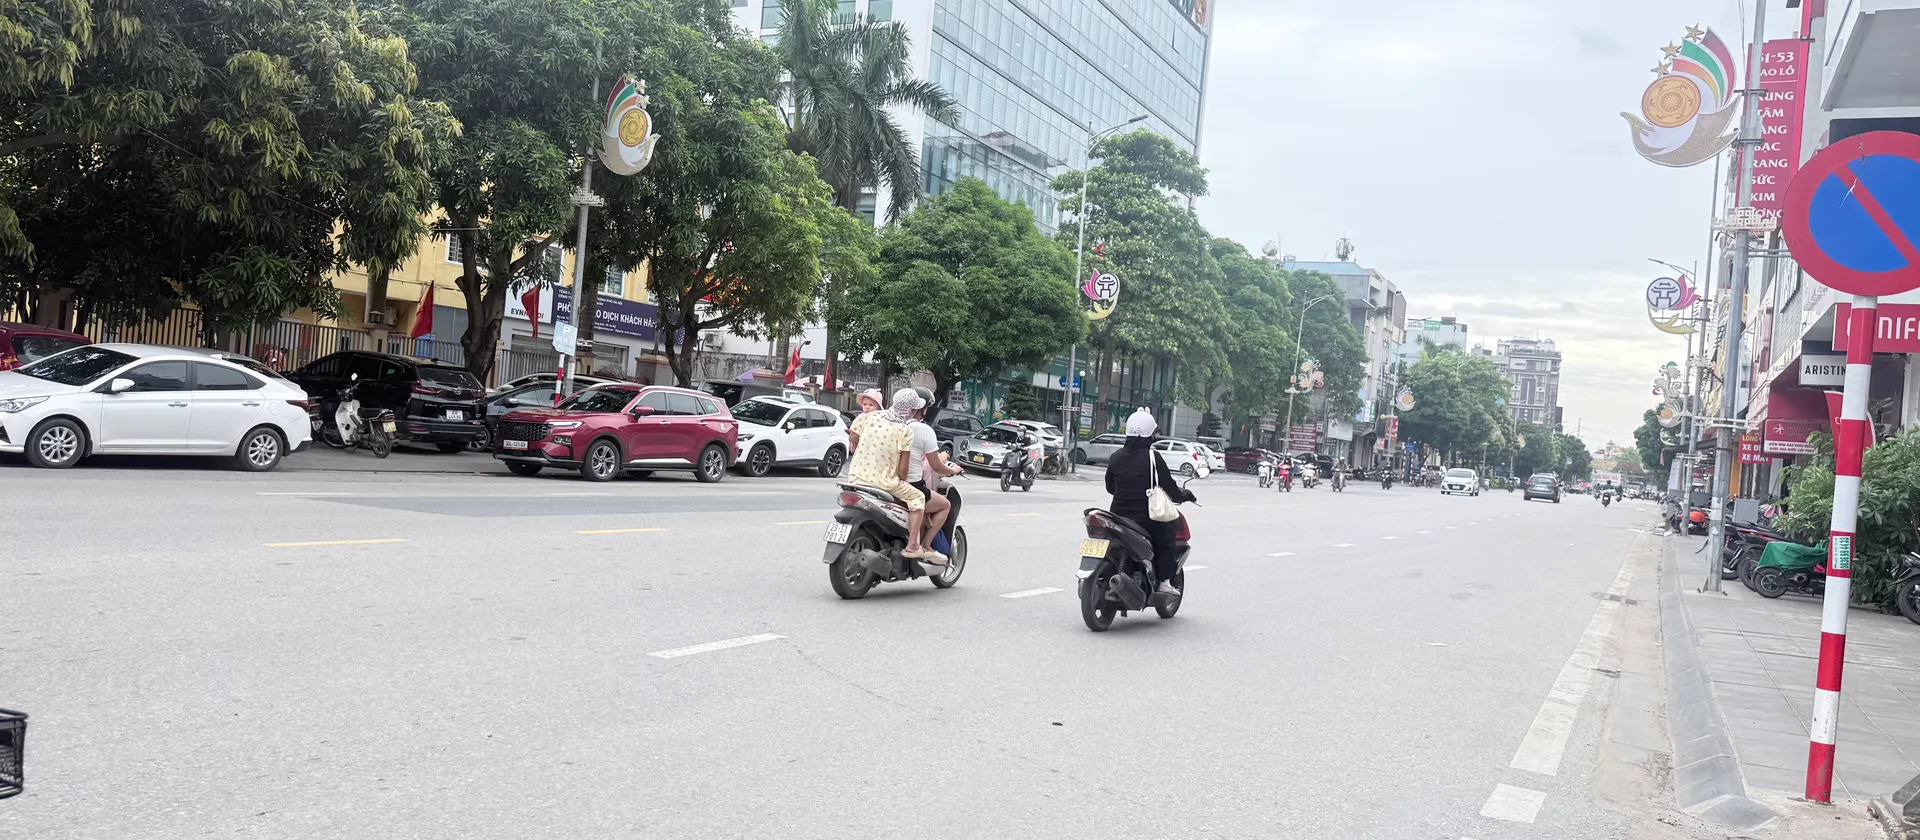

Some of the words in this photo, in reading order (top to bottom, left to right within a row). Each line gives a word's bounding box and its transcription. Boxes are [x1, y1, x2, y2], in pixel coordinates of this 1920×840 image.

[1760, 68, 1777, 76] AO
[1752, 158, 1788, 168] RANG
[1750, 192, 1776, 202] KIM
[602, 310, 619, 322] DỊCH
[620, 313, 643, 326] KHÁCH
[1741, 443, 1752, 451] XE
[1741, 453, 1752, 461] XE
